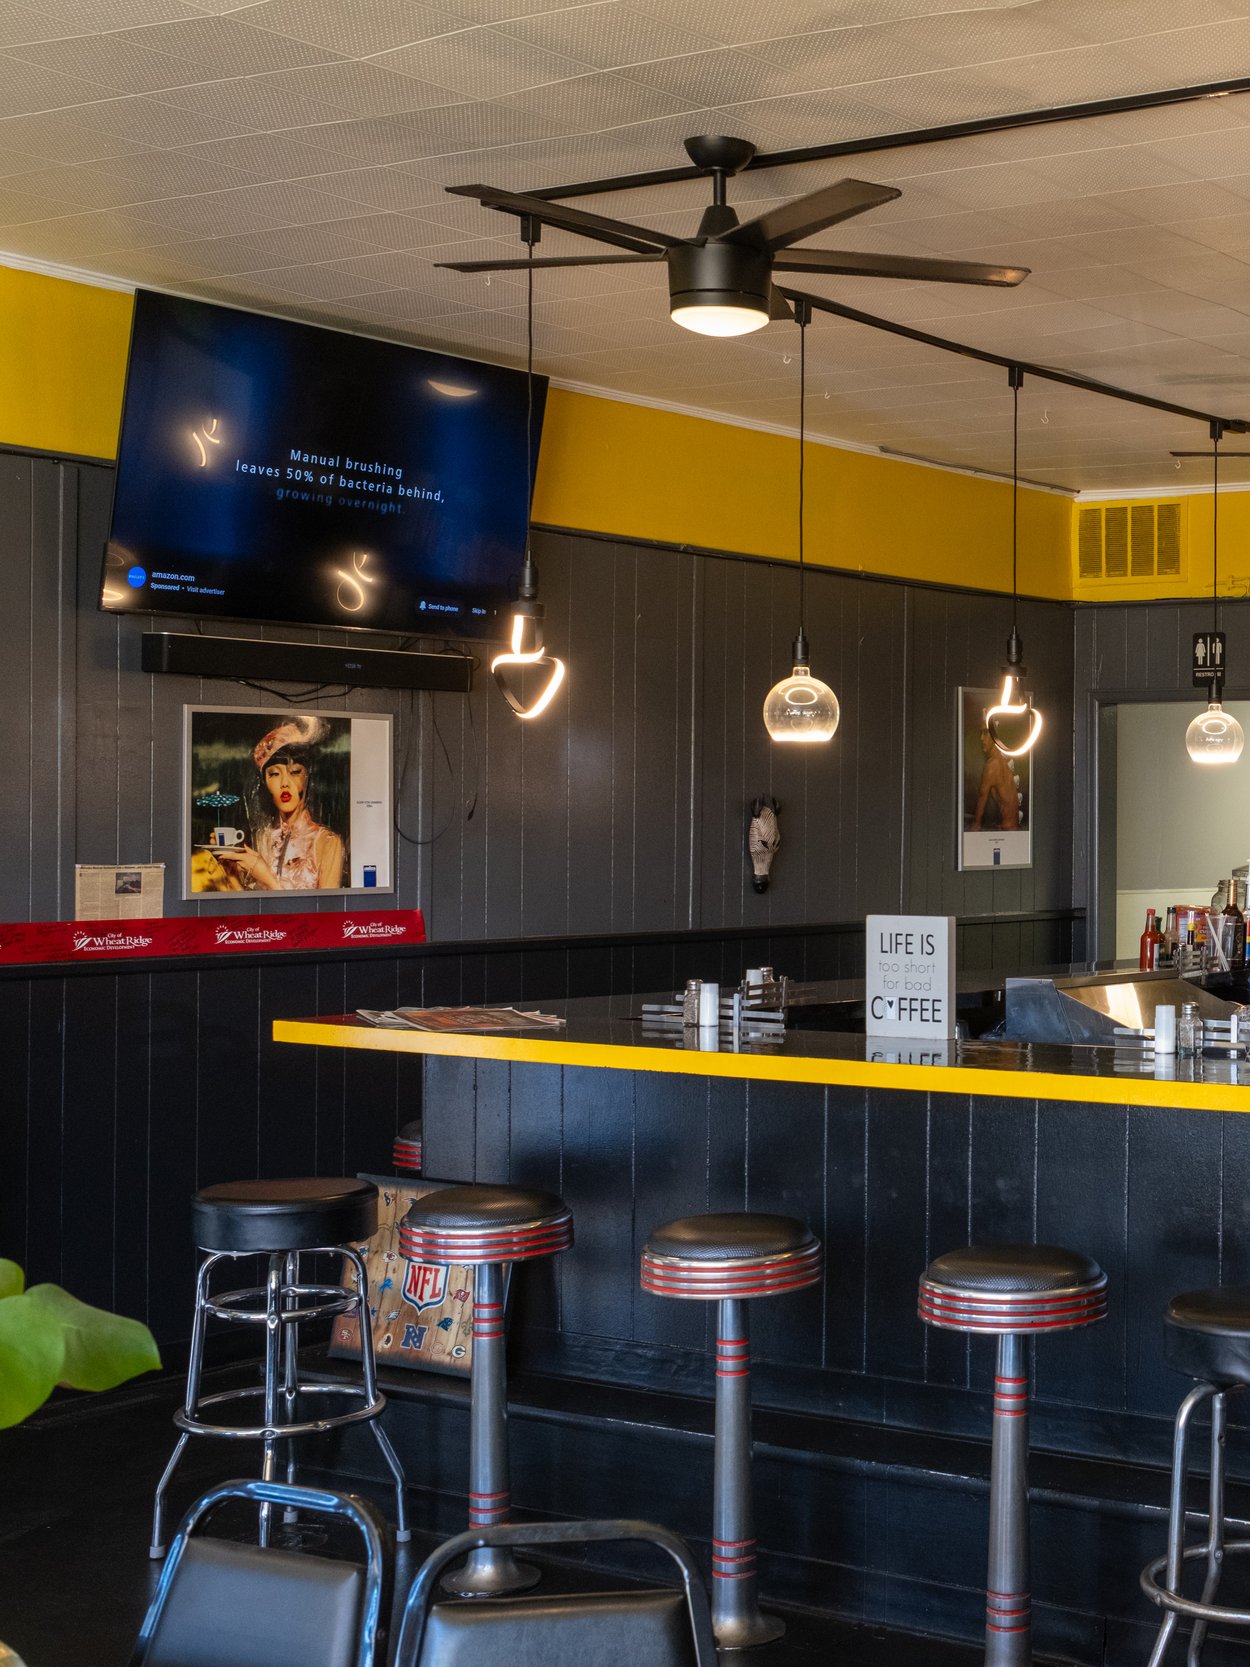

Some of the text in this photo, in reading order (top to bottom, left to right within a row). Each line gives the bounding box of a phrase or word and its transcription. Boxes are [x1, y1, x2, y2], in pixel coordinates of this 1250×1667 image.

[290, 449, 403, 480] Manual brushing
[235, 460, 445, 503] leaves 50% of bacteria behind,
[276, 487, 333, 506] growing
[151, 571, 196, 582] amazon.com
[150, 582, 226, 596] Sponsored Visit advertiser
[233, 930, 287, 940] Wheat Ridge
[358, 925, 406, 935] Wheat Ridge
[92, 935, 153, 947] Wheat Ridge
[880, 932, 935, 956] LIFE IS
[879, 958, 936, 974] too short
[883, 974, 932, 991] for bad
[406, 1264, 442, 1302] NFL
